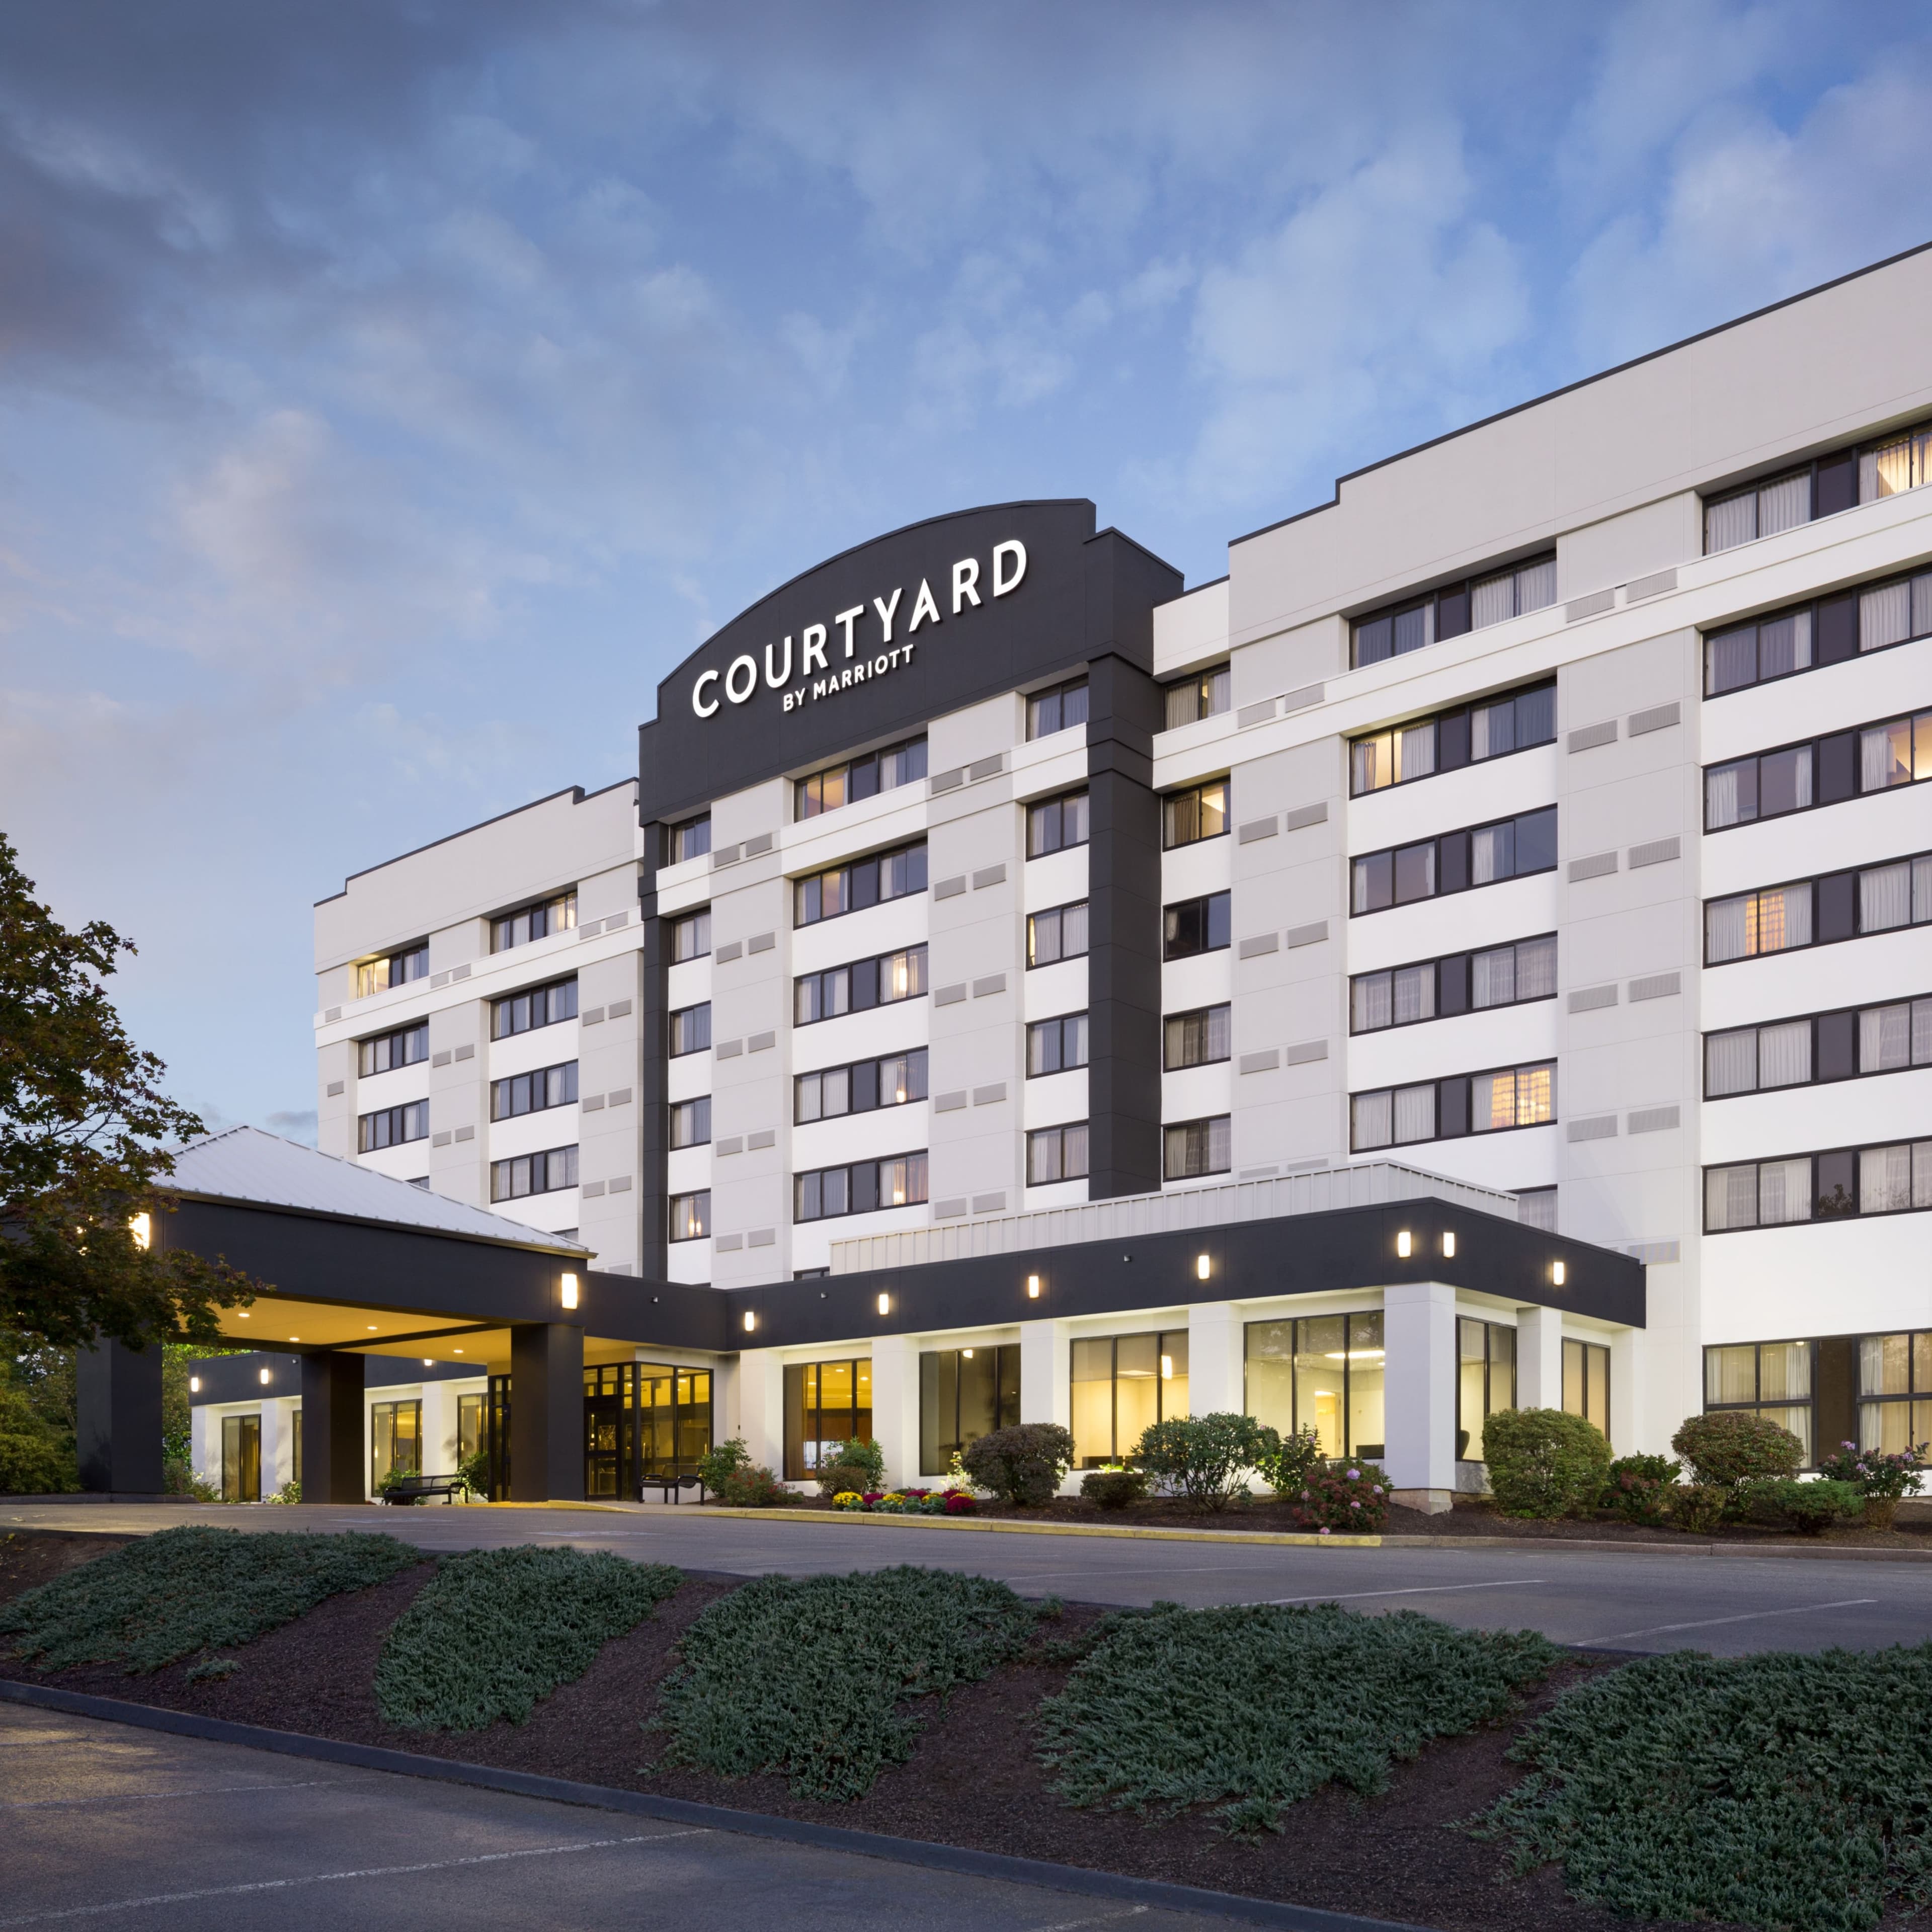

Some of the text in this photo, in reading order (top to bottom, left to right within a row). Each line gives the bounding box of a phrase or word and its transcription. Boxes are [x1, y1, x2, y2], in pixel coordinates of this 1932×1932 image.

[692, 539, 1027, 718] COURTYARD
[783, 643, 914, 712] BY MARRIOTT
